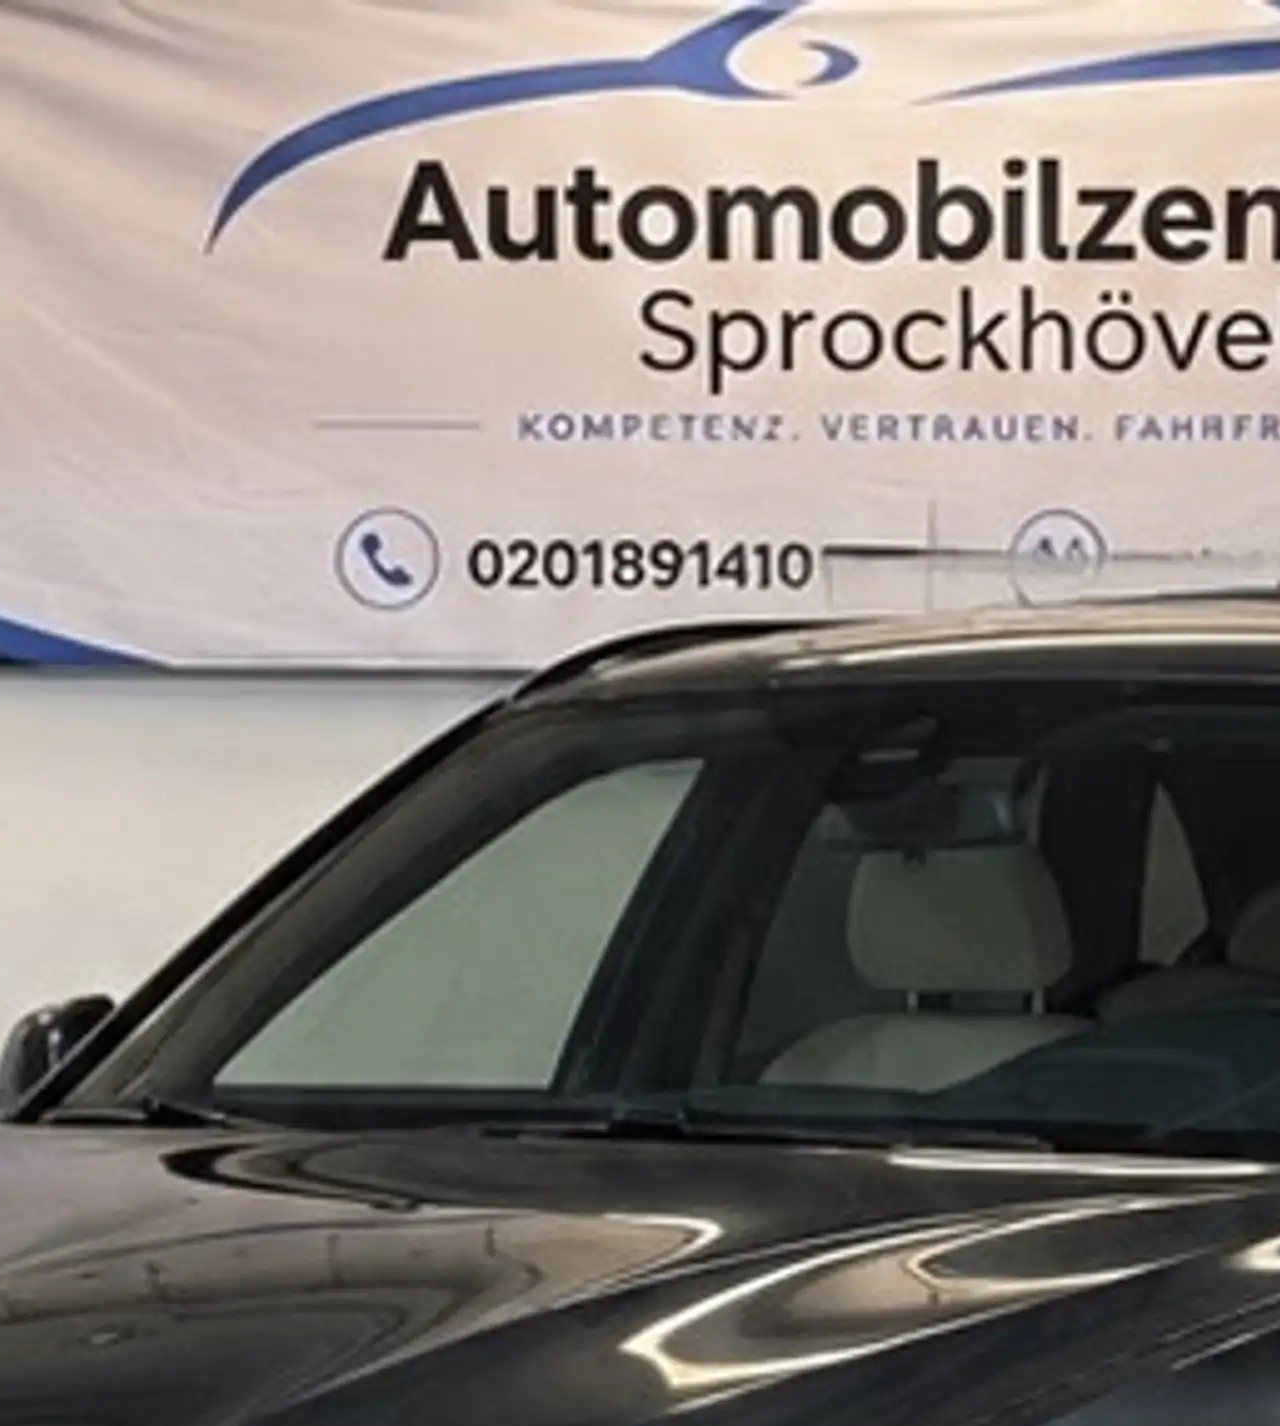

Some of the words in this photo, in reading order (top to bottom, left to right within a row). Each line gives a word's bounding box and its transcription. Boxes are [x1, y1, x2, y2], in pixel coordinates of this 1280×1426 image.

[518, 413, 801, 442] KOMPETENZ.
[821, 413, 1093, 442] VERTRAUEN.
[467, 538, 813, 590] 0201891410
